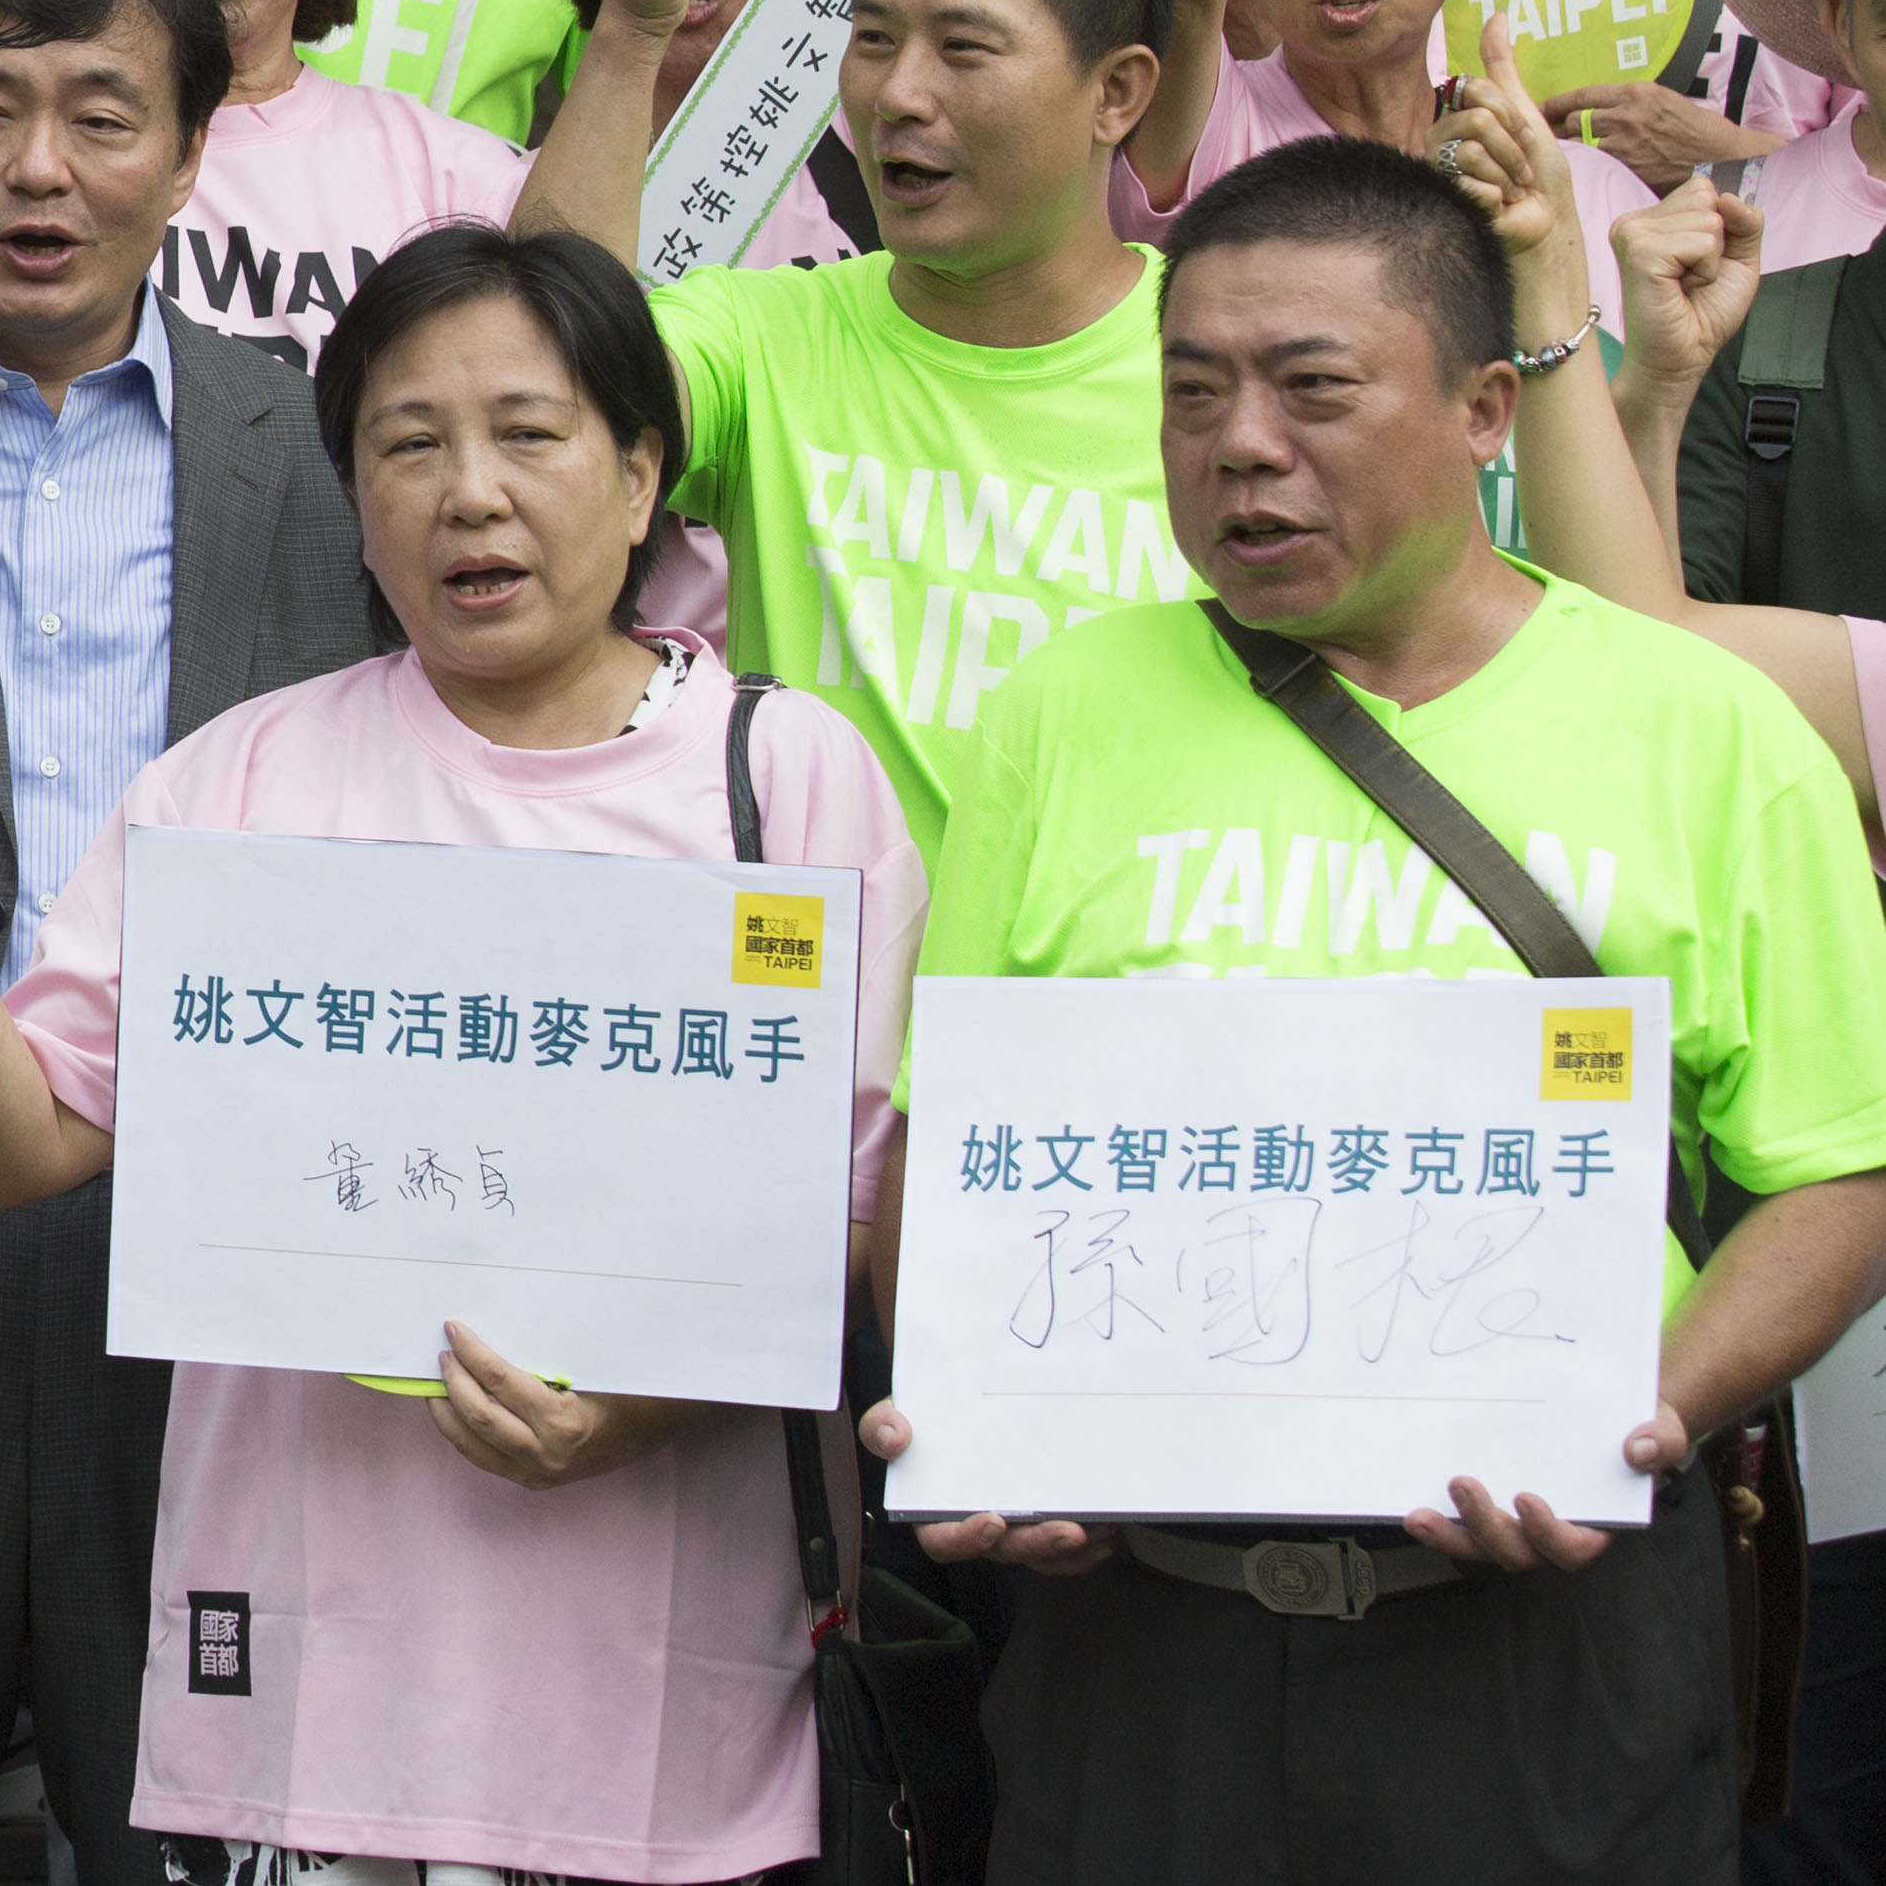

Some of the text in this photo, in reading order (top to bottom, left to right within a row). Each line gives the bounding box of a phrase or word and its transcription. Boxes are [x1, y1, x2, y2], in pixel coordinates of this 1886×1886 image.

[802, 435, 1194, 606] TAIWAN
[745, 914, 800, 936] 姚文智
[744, 934, 815, 958] 國家首都
[763, 955, 814, 972] TAIPEI
[171, 972, 807, 1086] 姚文智活動麥克風手
[1553, 1030, 1608, 1049] 姚文智
[1553, 1051, 1624, 1070] 國家首都
[1572, 1069, 1624, 1084] TAIPEI
[958, 1122, 1616, 1198] 姚文智活動麥克風手
[199, 1609, 240, 1643] 國家
[198, 1641, 240, 1677] 首都
